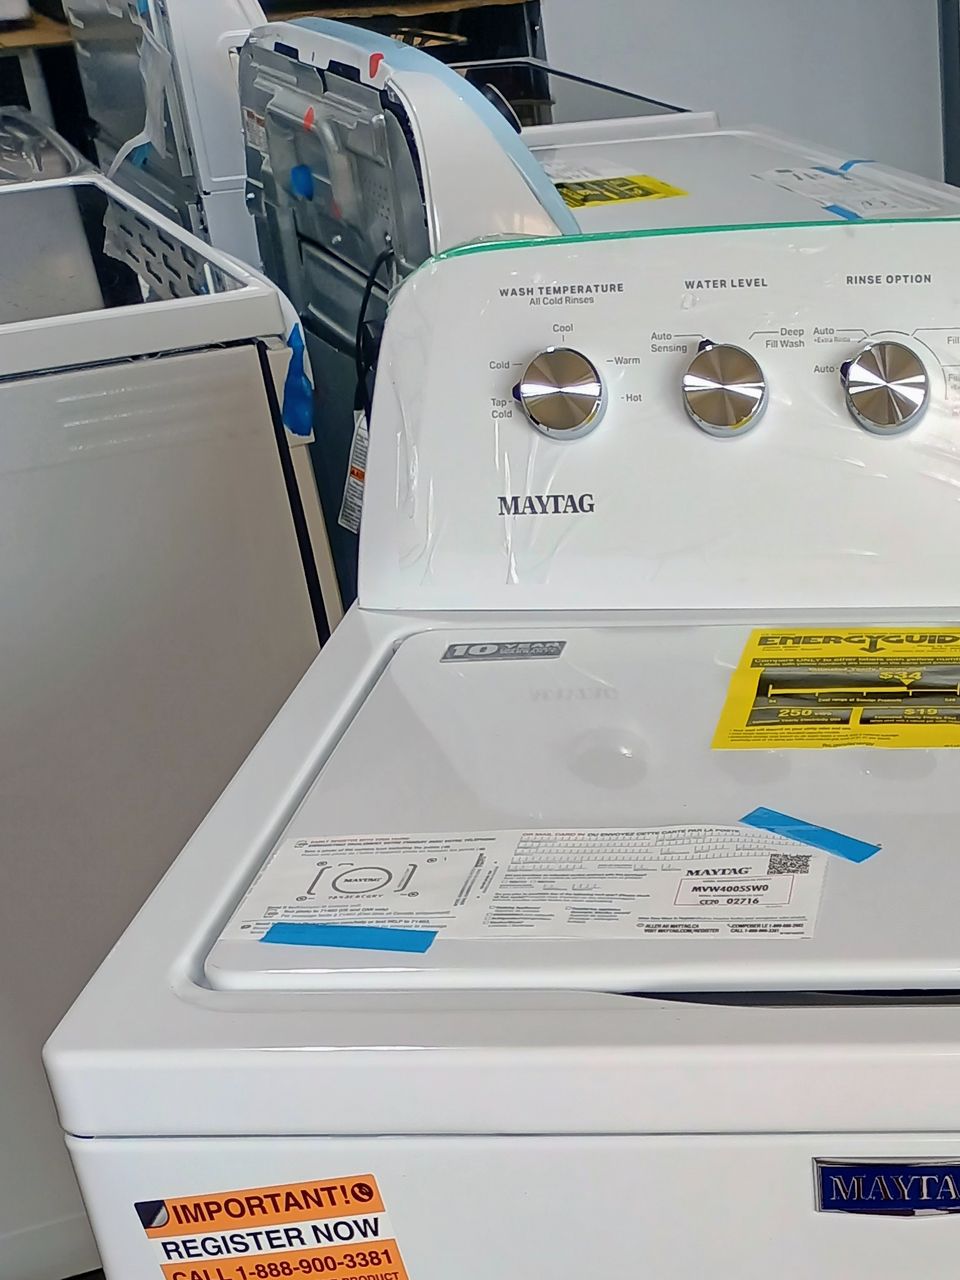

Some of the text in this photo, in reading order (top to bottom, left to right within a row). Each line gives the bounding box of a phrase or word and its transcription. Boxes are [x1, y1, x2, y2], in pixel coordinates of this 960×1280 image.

[684, 278, 768, 289] WATER LEVEL
[846, 274, 932, 285] RINSE OPTION
[499, 283, 624, 297] WASH TEMPERATURE
[529, 296, 594, 306] All Cold Rinses
[552, 323, 574, 332] Cool
[780, 327, 805, 337] Deep
[813, 327, 835, 336] Auto
[651, 331, 672, 341] Auto
[947, 336, 960, 345] Fill
[651, 343, 688, 353] Sensing
[765, 339, 805, 348] Fill Wash
[614, 356, 641, 365] Warm
[489, 361, 510, 370] Cold
[813, 365, 835, 373] Auto
[626, 393, 642, 402] Hot
[491, 398, 507, 408] Tap
[491, 409, 513, 418] Cold
[497, 493, 595, 516] MAYTAG
[453, 644, 498, 656] 10
[778, 708, 813, 717] 250
[904, 708, 938, 716] $19
[686, 867, 749, 876] MAYTAG
[726, 897, 760, 905] 02716
[172, 1184, 350, 1225] IMPORTANT!
[161, 1217, 380, 1260] REGISTER NOW
[235, 1249, 393, 1280] 1-888-900-3381
